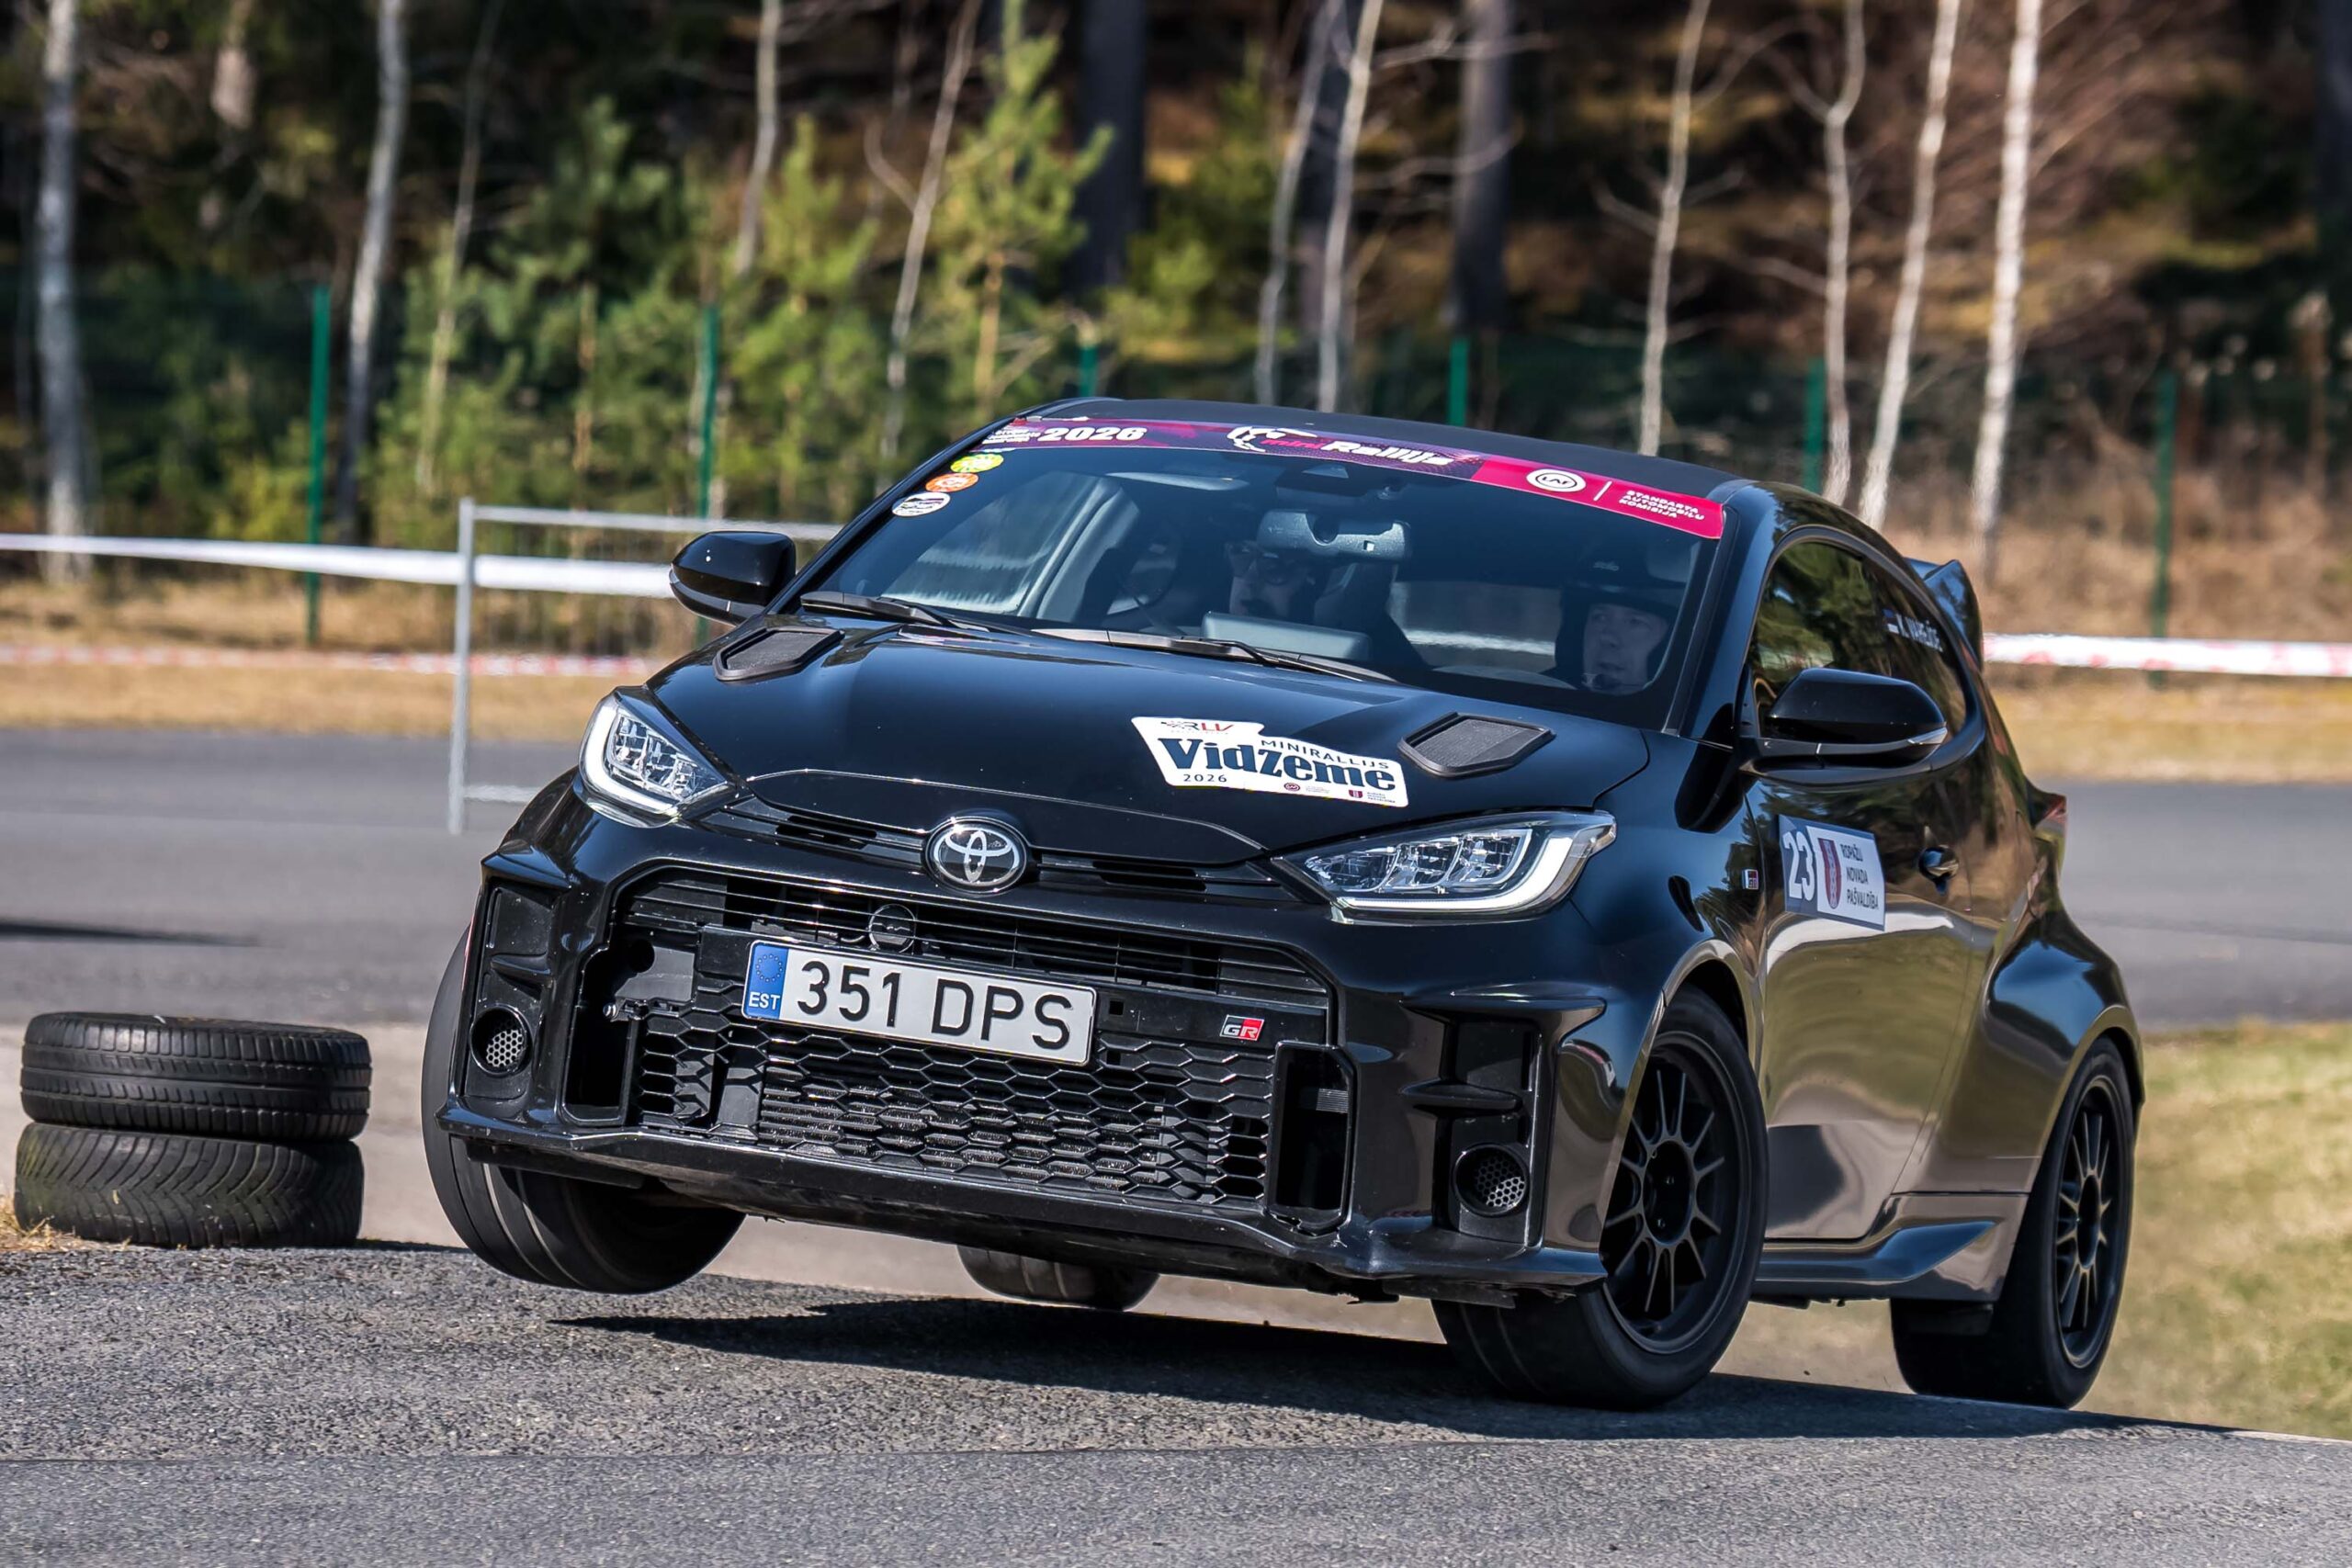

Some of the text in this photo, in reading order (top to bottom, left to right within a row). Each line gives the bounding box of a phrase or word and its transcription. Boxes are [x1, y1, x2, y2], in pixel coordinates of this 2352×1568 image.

[1037, 426, 1148, 443] 2026
[1157, 738, 1396, 792] Vidzeme
[1260, 739, 1390, 770] MINIRALLIJS
[1182, 773, 1227, 783] 2026
[1781, 830, 1815, 902] 23
[1846, 866, 1869, 886] NOVADA
[748, 990, 781, 1011] EST
[797, 960, 1075, 1050] 351 DPS
[1223, 1023, 1260, 1039] GR
